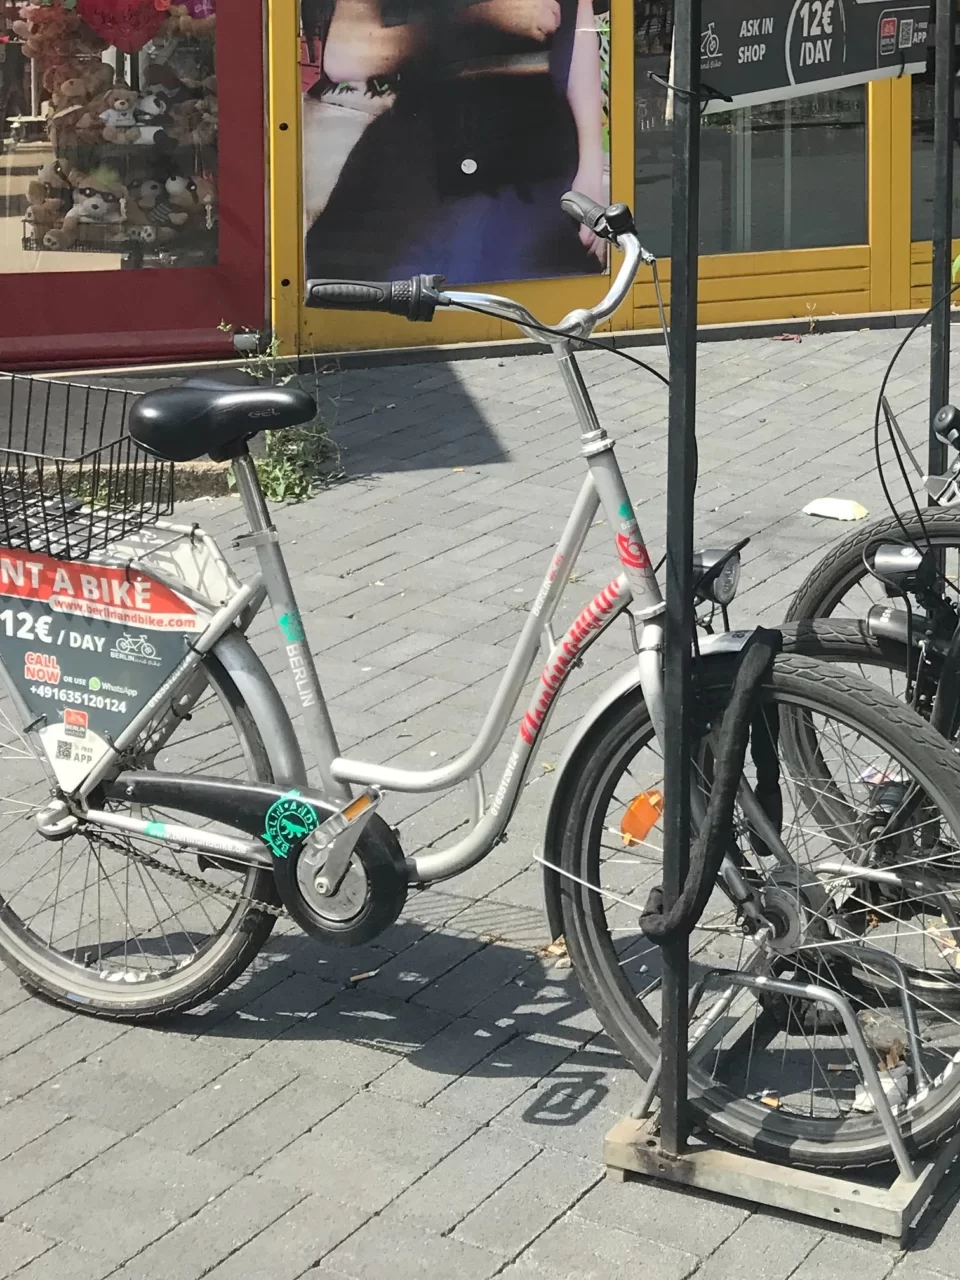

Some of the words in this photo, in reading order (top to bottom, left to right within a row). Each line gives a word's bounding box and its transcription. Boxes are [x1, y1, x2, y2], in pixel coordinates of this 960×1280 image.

[739, 19, 762, 38] ASK
[761, 17, 774, 36] IN
[799, 0, 835, 37] 12€
[912, 31, 927, 44] APP
[738, 44, 766, 64] SHOP
[0, 558, 43, 589] NT
[52, 568, 75, 596] A
[79, 574, 152, 610] BIKE
[532, 577, 553, 617] BERLIN
[53, 598, 196, 628] www.berlinandbike.com
[0, 609, 53, 643] 12€
[69, 632, 106, 653] DAY
[25, 651, 60, 670] CALL
[110, 651, 135, 662] BERLIN
[24, 666, 61, 684] NOW
[63, 675, 73, 684] OR
[74, 676, 87, 686] USE
[101, 682, 138, 697] WhatsApp
[286, 644, 316, 708] BERLIN
[29, 685, 127, 714] +491635120124
[65, 721, 86, 732] BERLIN
[73, 753, 93, 764] APP
[490, 751, 520, 817] 01635120124
